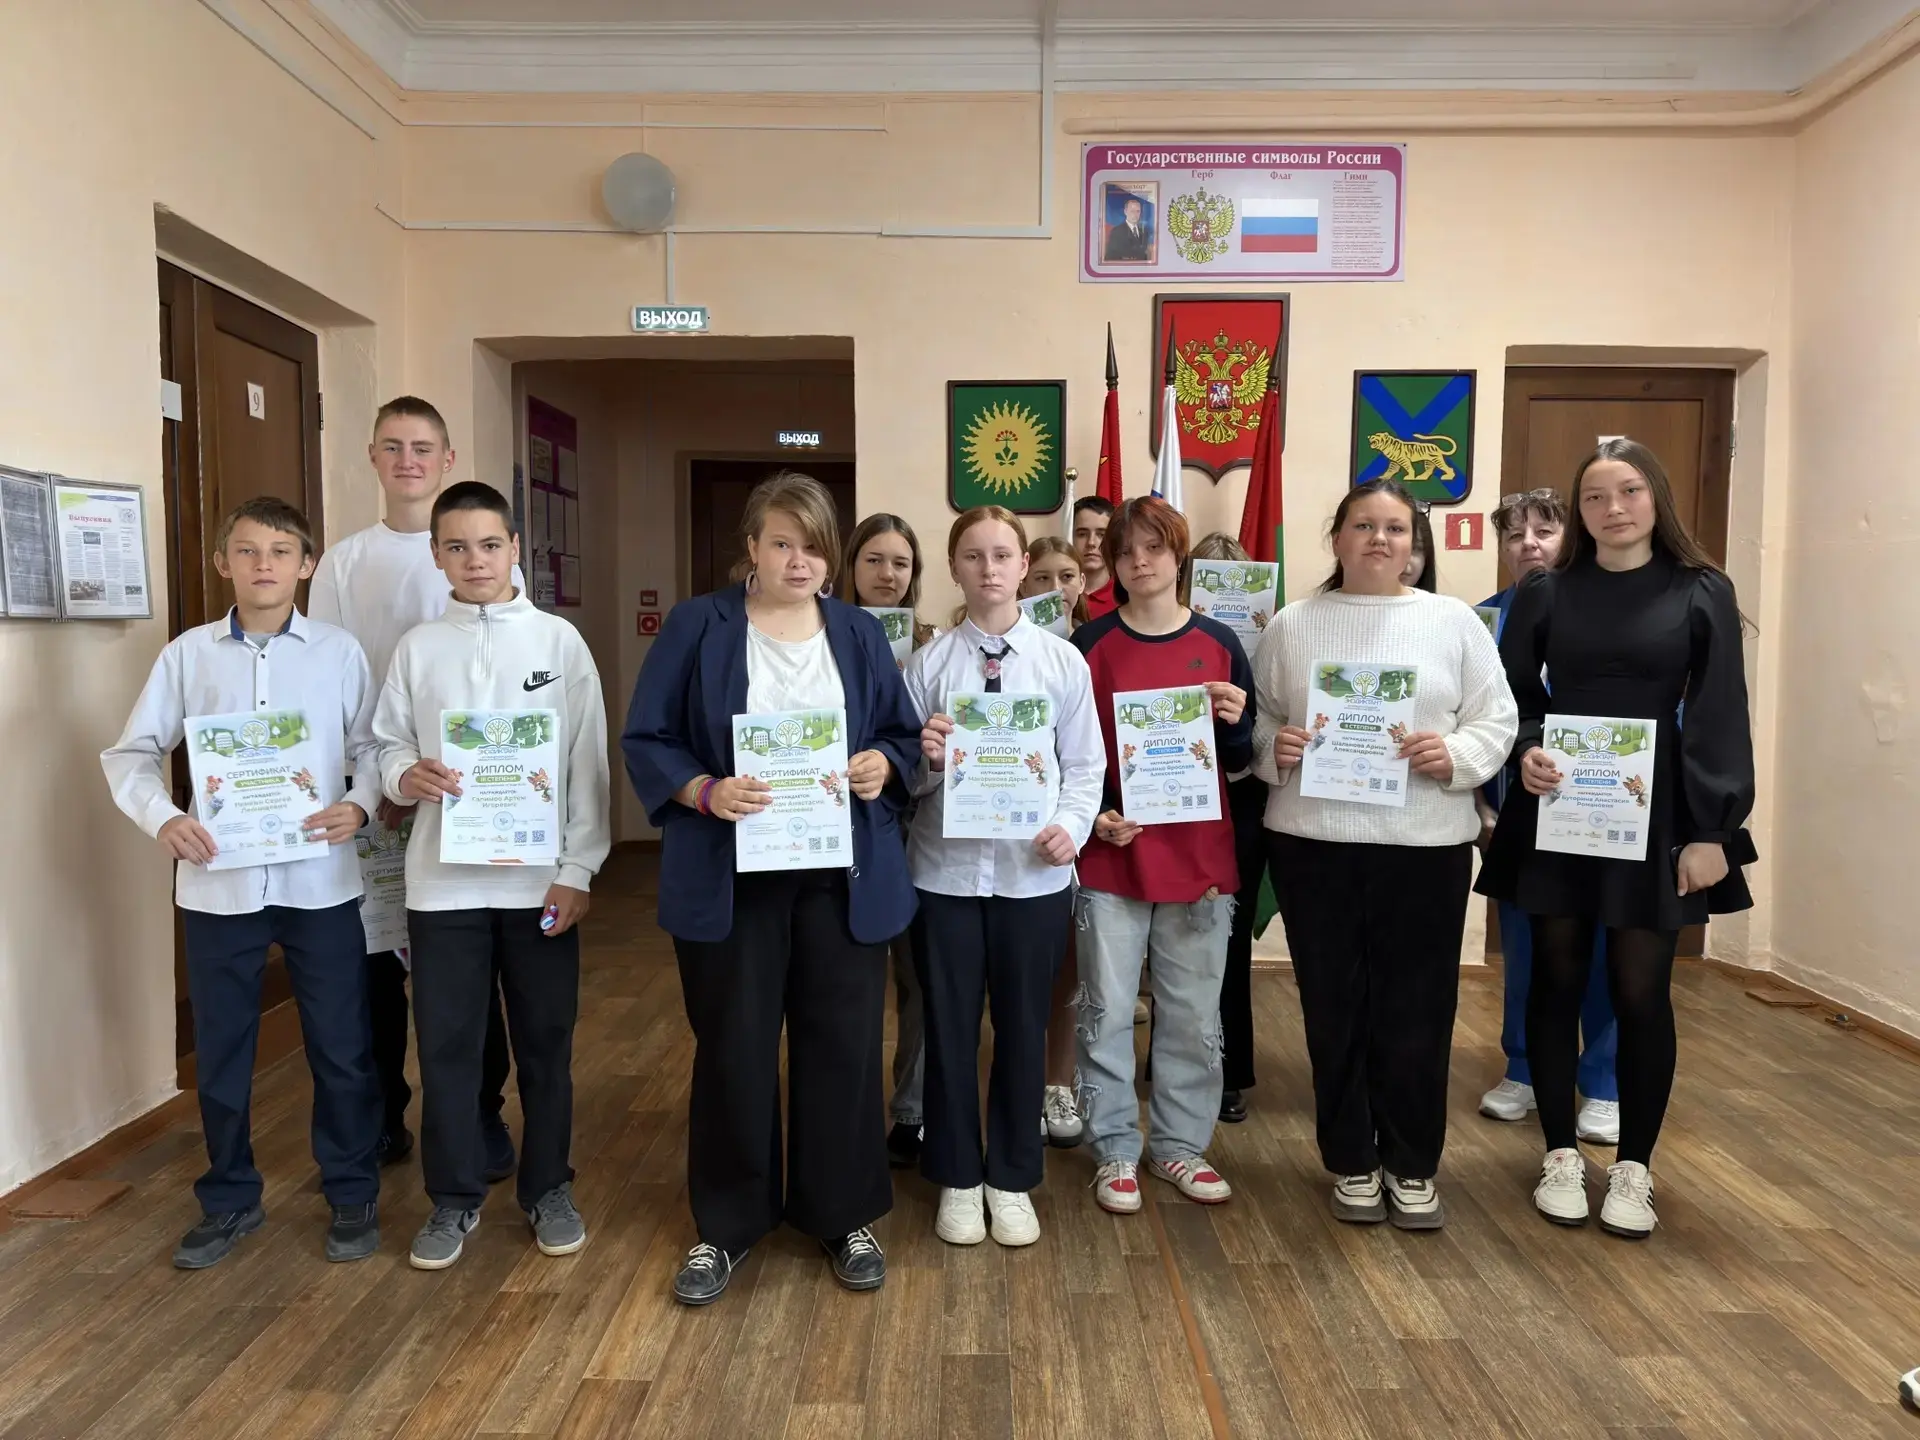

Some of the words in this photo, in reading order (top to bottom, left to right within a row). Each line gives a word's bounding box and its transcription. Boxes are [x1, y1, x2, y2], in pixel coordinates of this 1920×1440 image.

[1107, 150, 1246, 167] Государственные
[1252, 152, 1320, 164] символы
[1327, 150, 1382, 164] России
[1191, 170, 1214, 180] Герб
[1270, 171, 1292, 180] Флаг
[1344, 172, 1368, 180] Гимн
[640, 311, 703, 326] ВЫХОД
[253, 392, 260, 411] 9
[779, 433, 820, 445] ВЫХОД
[1211, 604, 1250, 612] ДИПЛОМ
[532, 671, 551, 683] NIKE
[1337, 712, 1385, 724] ДИПЛОМ
[1143, 737, 1186, 749] ДИПЛОМ
[974, 746, 1021, 755] ДИПЛОМ
[226, 765, 291, 779] СЕРТИФИКАТ
[472, 764, 524, 775] ДИПЛОМ
[759, 767, 821, 778] СЕРТИФИКАТ
[1572, 768, 1620, 778] ДИПЛОМ
[771, 779, 810, 787] УЧАСТНИКА
[366, 866, 405, 877] СЕРТИФИ
